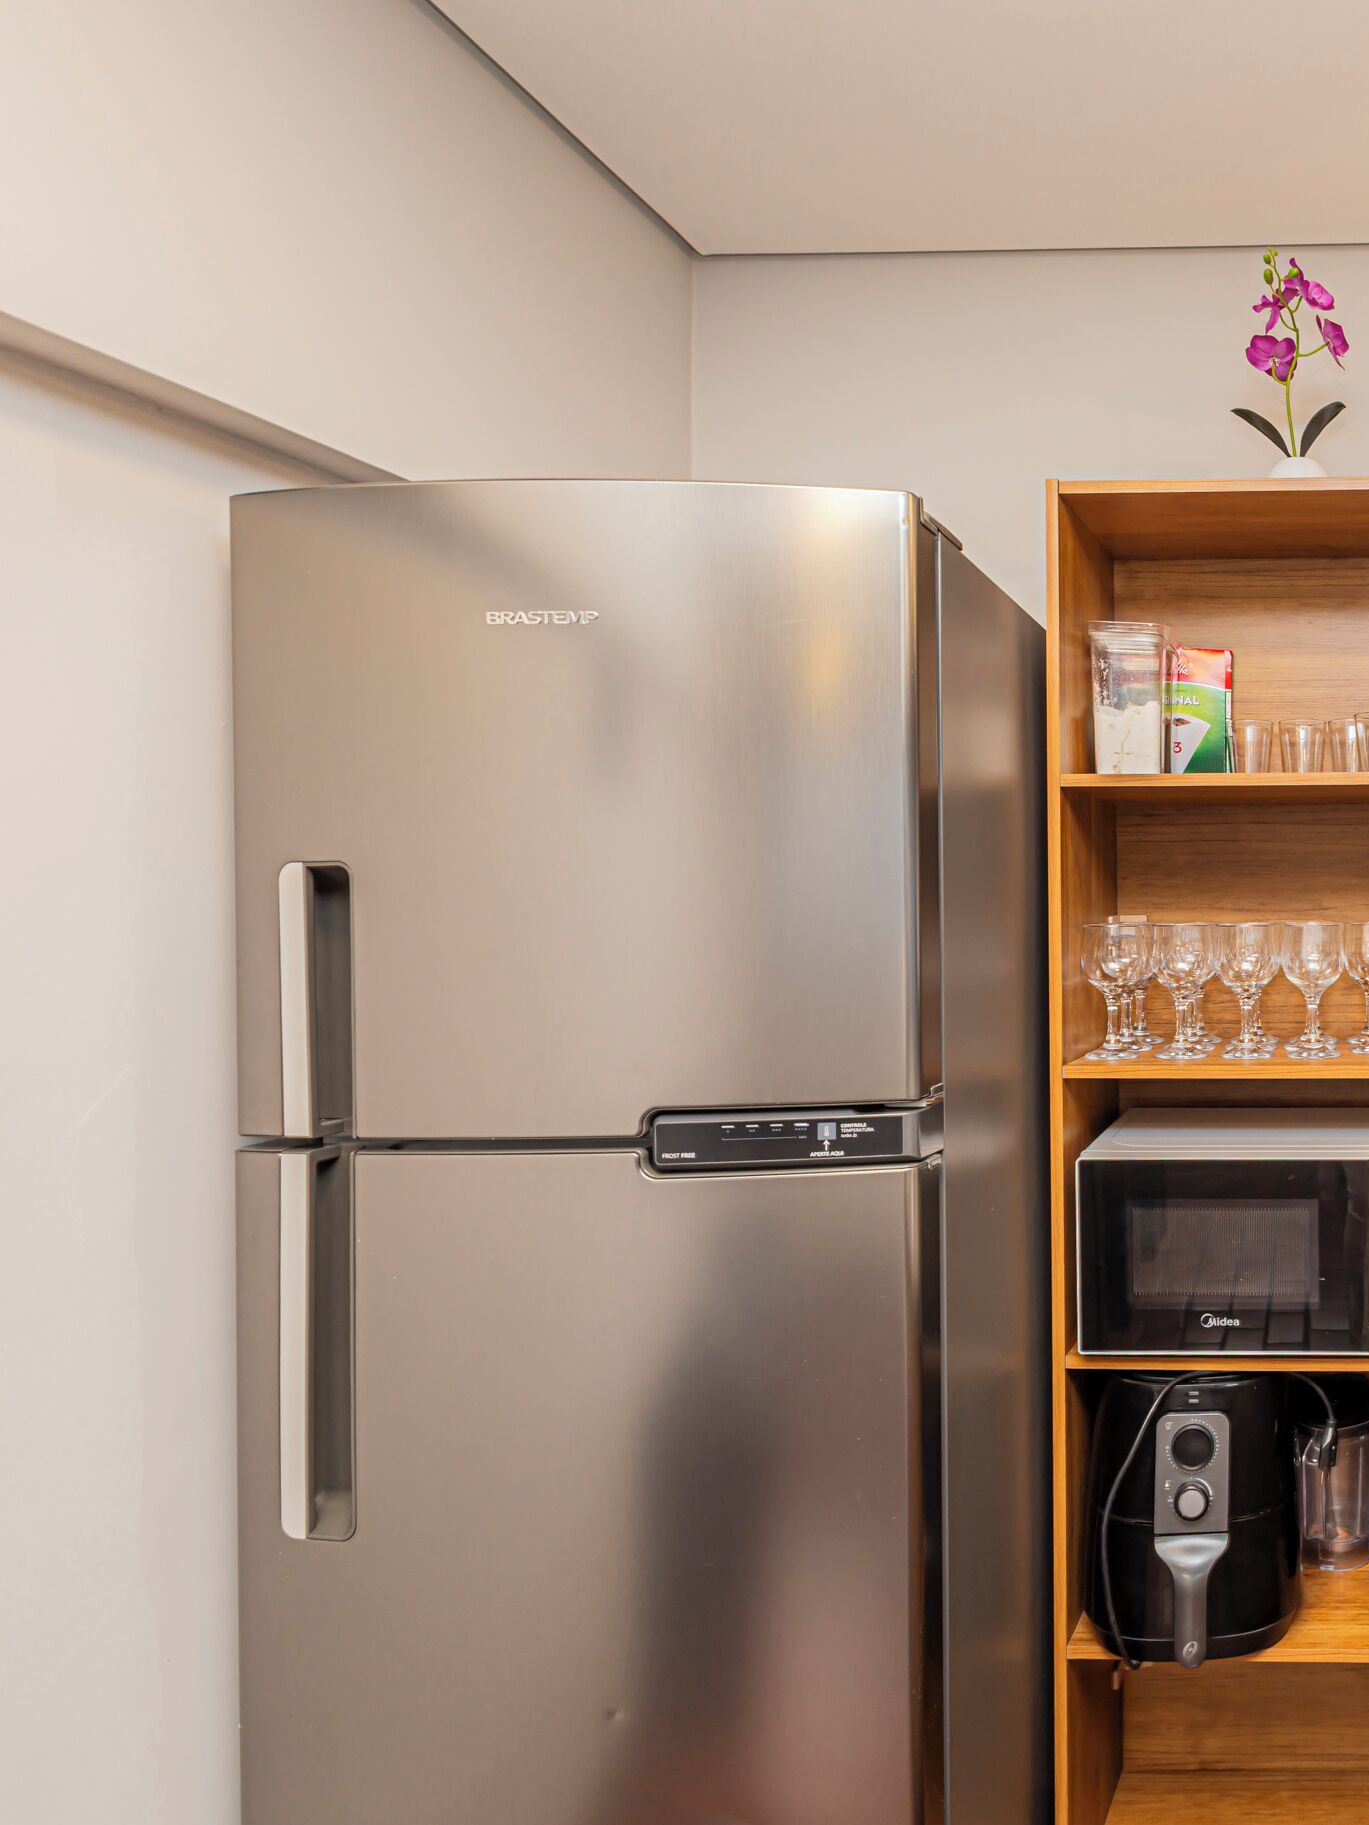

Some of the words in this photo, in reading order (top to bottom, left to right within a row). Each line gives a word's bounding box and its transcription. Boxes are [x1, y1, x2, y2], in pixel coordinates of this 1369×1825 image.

[485, 610, 599, 625] BRASTEMP
[1172, 741, 1182, 754] 3
[1201, 1313, 1240, 1327] Midea
